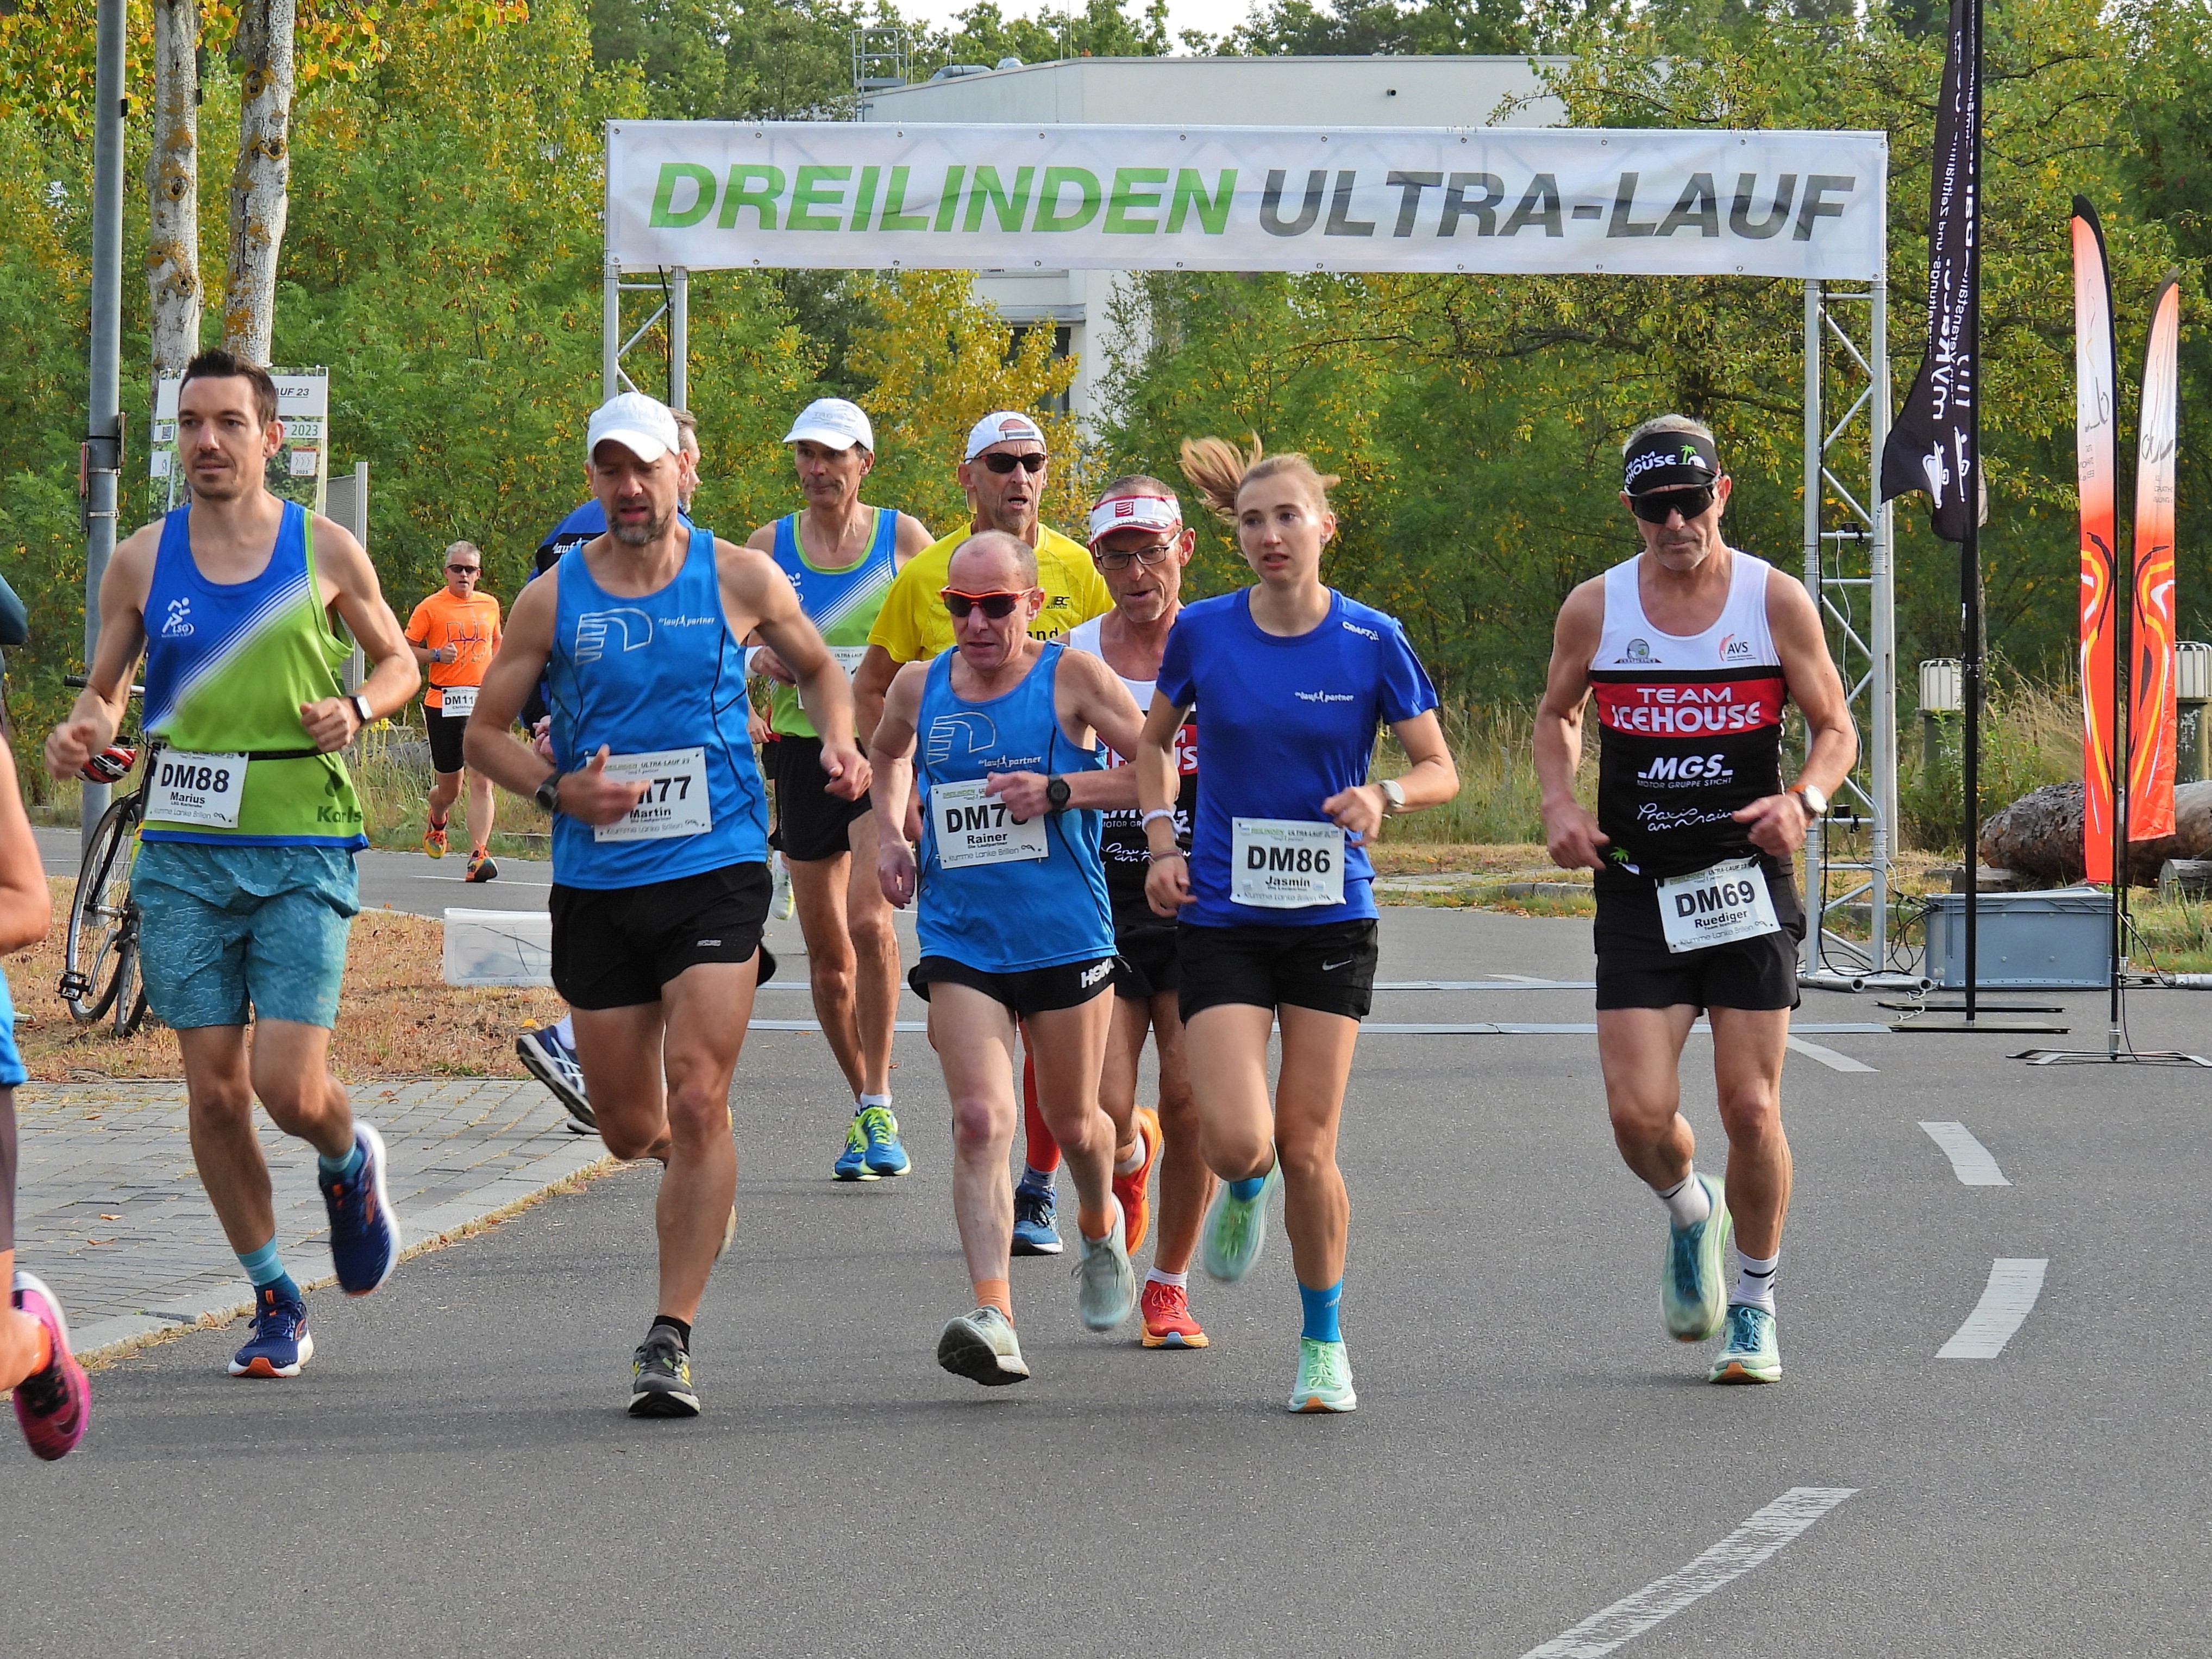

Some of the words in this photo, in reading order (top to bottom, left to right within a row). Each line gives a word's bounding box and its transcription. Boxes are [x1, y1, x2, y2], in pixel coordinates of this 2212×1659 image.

[649, 162, 1238, 235] DREILINDEN
[1259, 168, 1856, 242] ULTRA-LAUF
[291, 424, 318, 436] 2023
[686, 617, 716, 627] partner
[173, 624, 189, 634] LSG
[1727, 641, 1749, 654] AVS
[1636, 686, 1732, 704] TEAM
[1611, 701, 1761, 733] ICEHOUSE
[984, 758, 1001, 768] lauf
[1008, 756, 1042, 768] partner
[1647, 754, 1725, 780] MGS
[160, 763, 230, 793] DM88
[1637, 780, 1665, 788] MOTOR
[1668, 780, 1701, 789] GRUPPE
[170, 792, 205, 804] Marius
[629, 807, 671, 818] Martin
[967, 834, 1008, 845] Rainer
[1248, 845, 1330, 873] DM86
[1265, 875, 1310, 887] Jasmin
[1675, 880, 1755, 918] DM69
[1694, 910, 1747, 929] Ruediger
[1080, 956, 1115, 988] HOKA
